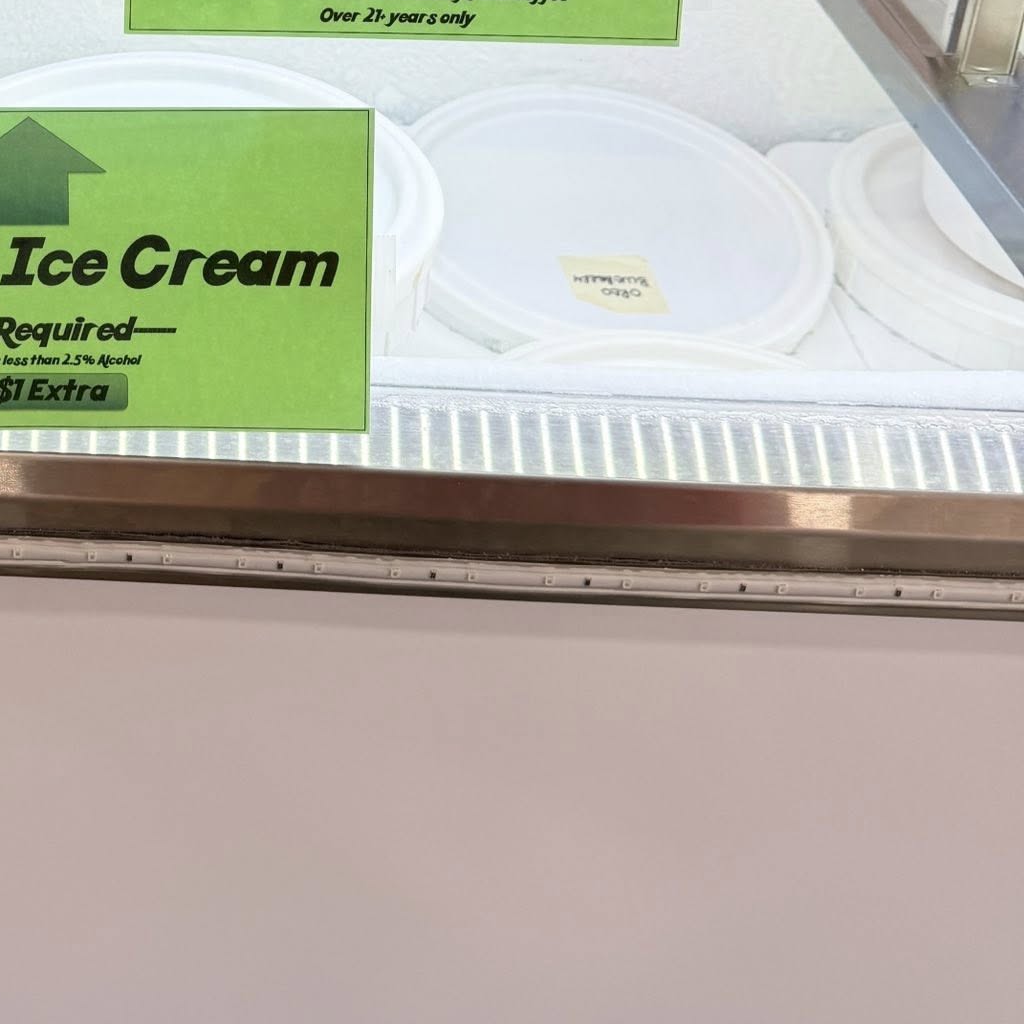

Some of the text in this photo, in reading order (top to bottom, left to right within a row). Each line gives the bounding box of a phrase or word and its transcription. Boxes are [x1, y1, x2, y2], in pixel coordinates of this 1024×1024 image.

[320, 8, 476, 28] Over 21+ years only
[0, 237, 108, 286] Ice
[121, 235, 339, 289] Cream
[3, 355, 28, 366] less
[31, 355, 60, 365] than
[62, 354, 95, 365] 2.5%
[97, 354, 142, 368] Alcohol
[28, 378, 109, 403] Extra
